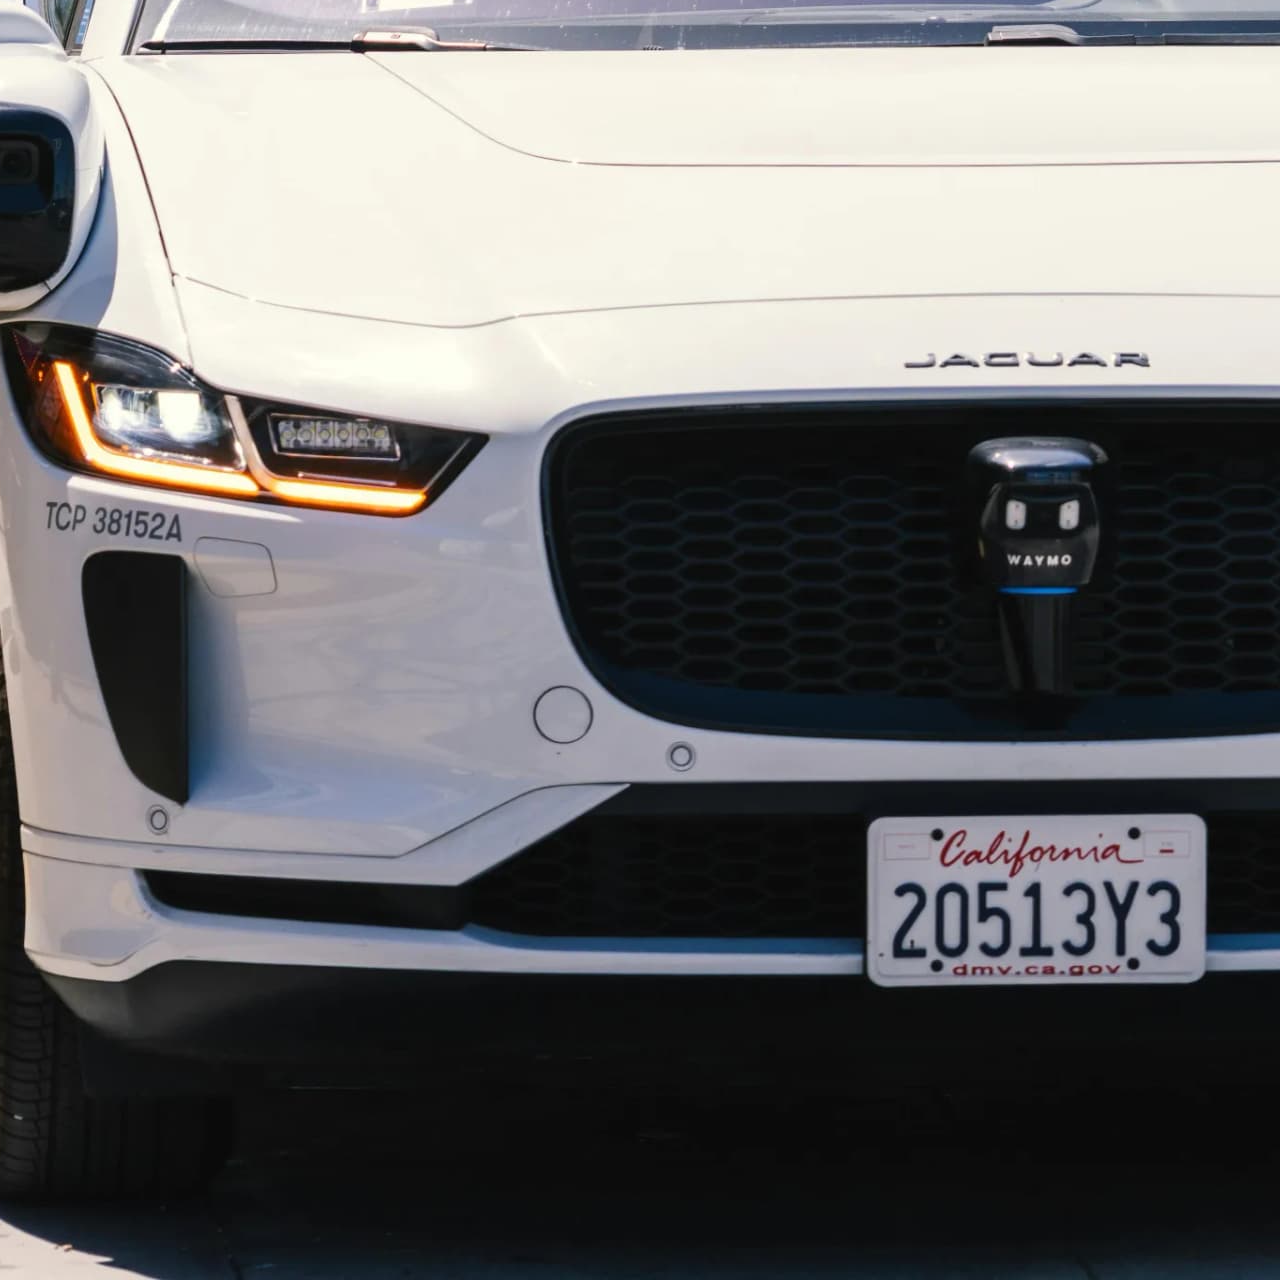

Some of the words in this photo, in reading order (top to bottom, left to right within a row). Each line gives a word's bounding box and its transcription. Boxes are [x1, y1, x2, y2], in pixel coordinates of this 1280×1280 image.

[904, 352, 1152, 369] JAGUAR
[46, 501, 87, 532] TCP
[92, 506, 183, 543] 38152A
[1007, 553, 1073, 568] WAYMO
[939, 829, 1145, 878] California
[892, 880, 1181, 959] 20513Y3
[951, 963, 1122, 976] dmv.ca.gov
